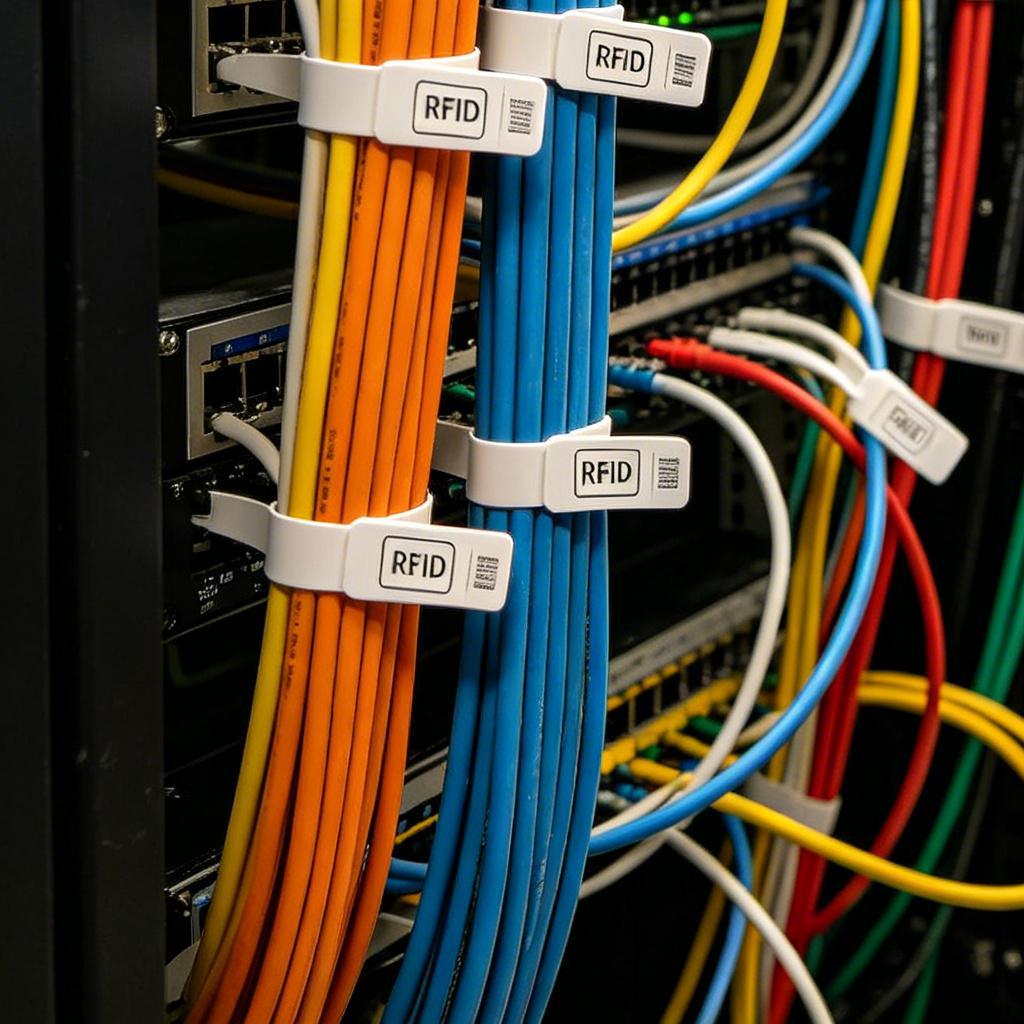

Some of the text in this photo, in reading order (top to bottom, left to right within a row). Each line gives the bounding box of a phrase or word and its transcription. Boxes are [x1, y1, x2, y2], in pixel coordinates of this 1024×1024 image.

[596, 43, 645, 73] RFID
[425, 94, 480, 123] RFID
[582, 461, 632, 486] RFID
[392, 550, 446, 579] RFID
